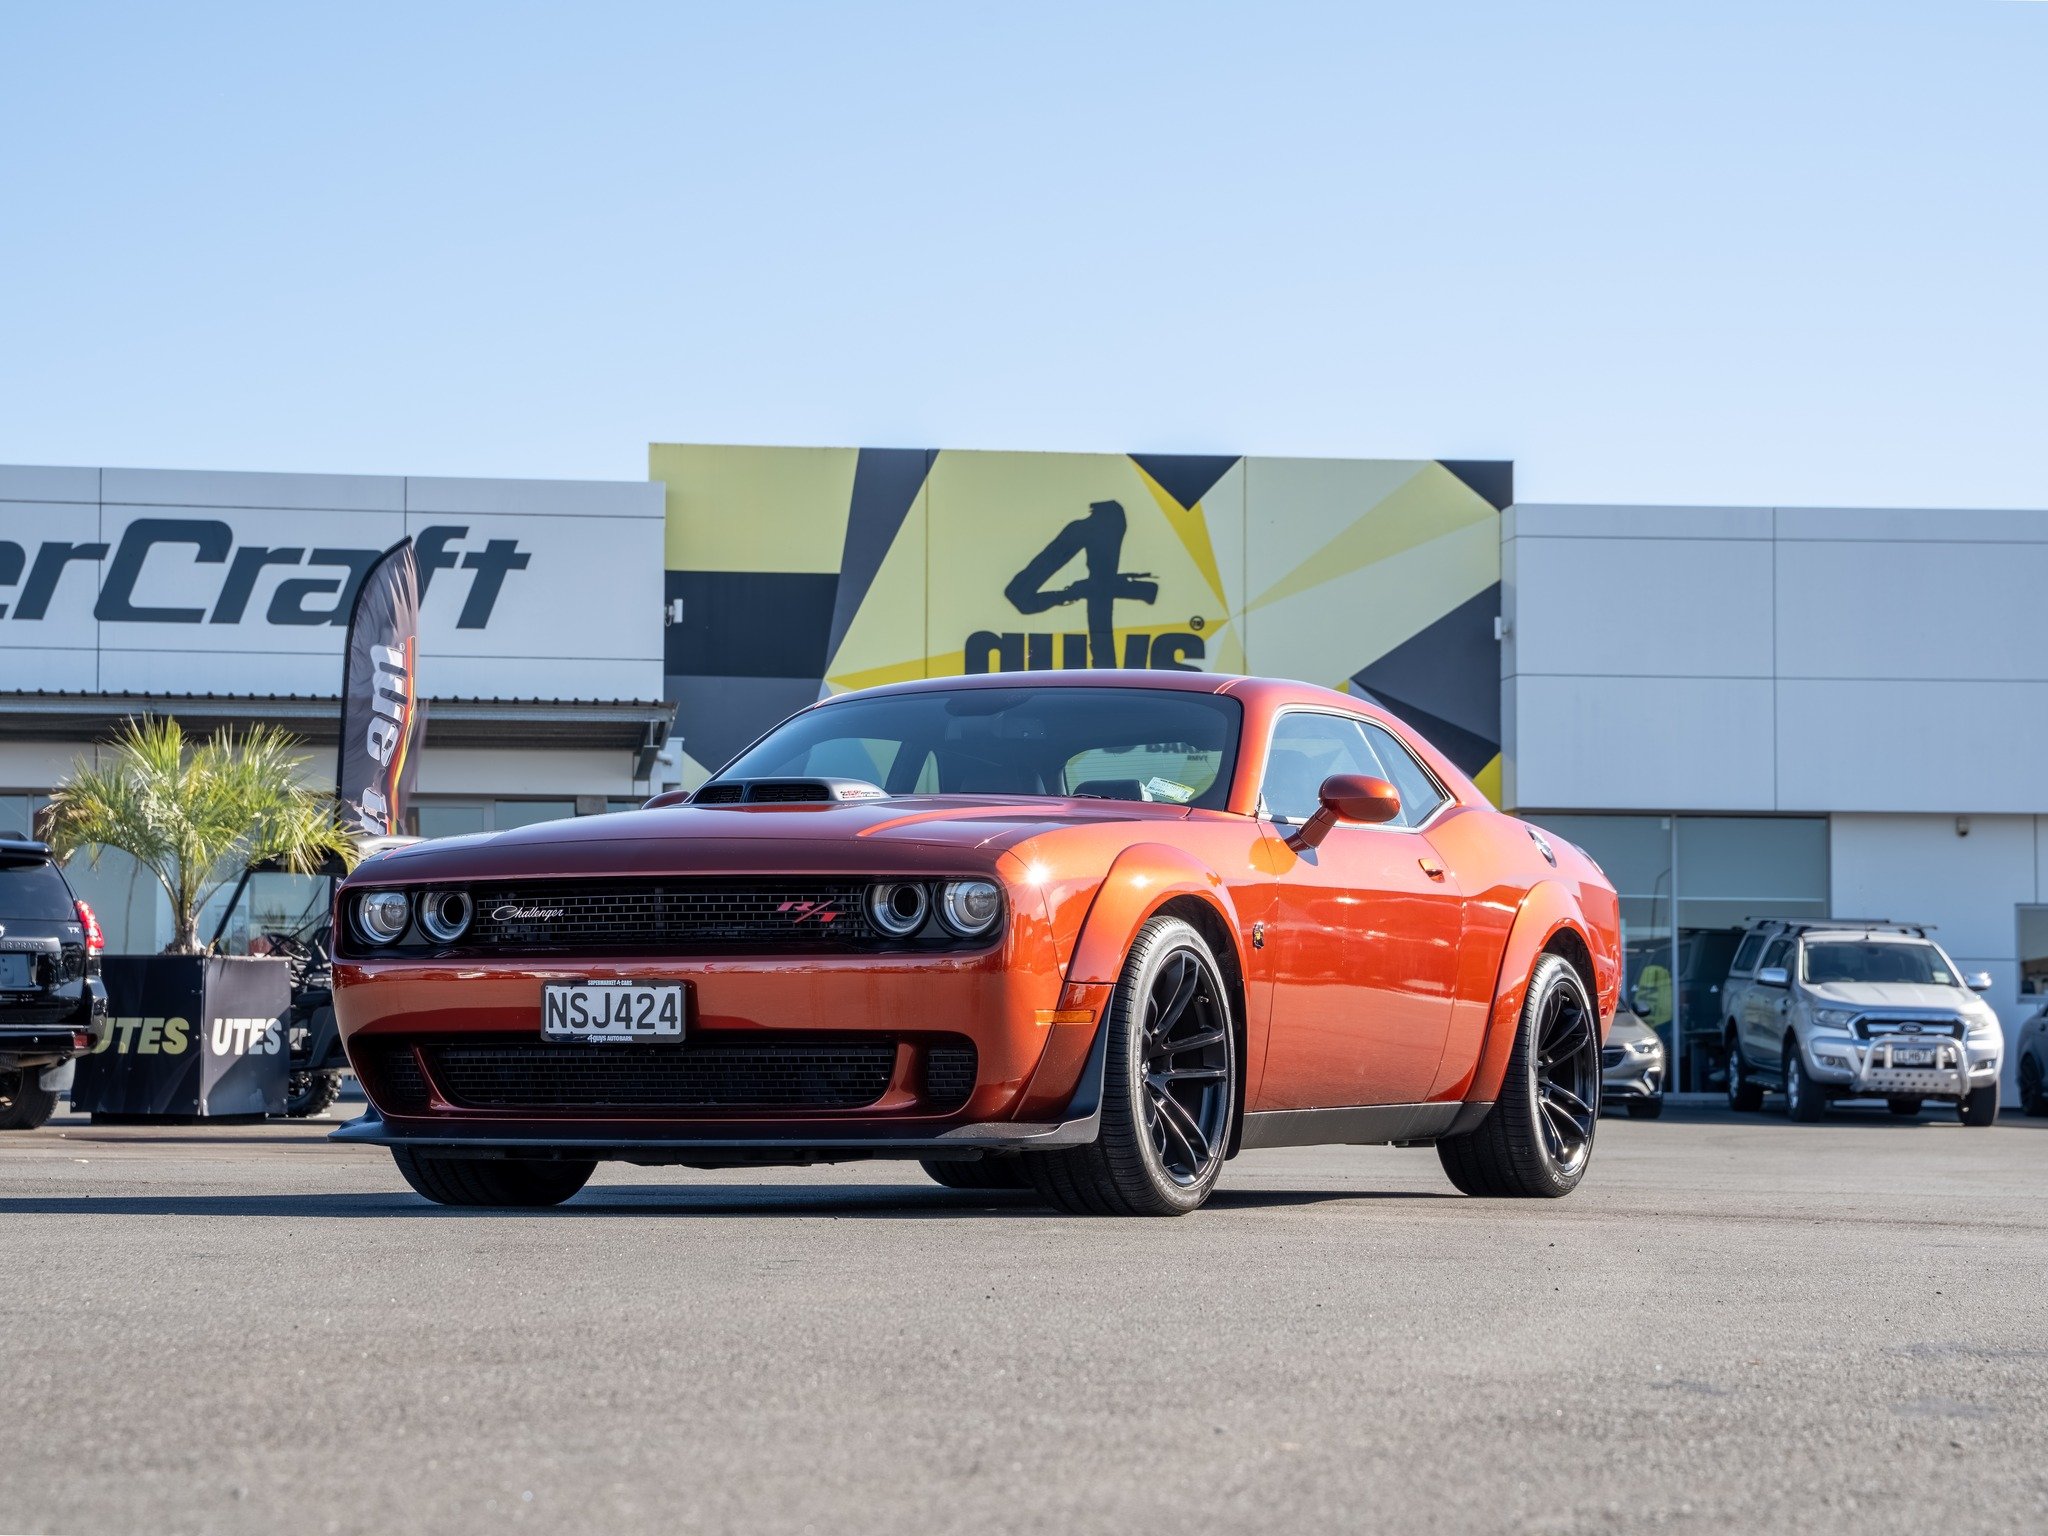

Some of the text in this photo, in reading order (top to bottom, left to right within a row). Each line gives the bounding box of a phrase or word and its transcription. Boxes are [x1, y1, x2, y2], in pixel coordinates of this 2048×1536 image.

[0, 518, 532, 629] rCraft
[1004, 500, 1160, 669] 4
[491, 905, 564, 921] Challenger
[548, 992, 678, 1030] NSJ424
[211, 1018, 283, 1057] UTES
